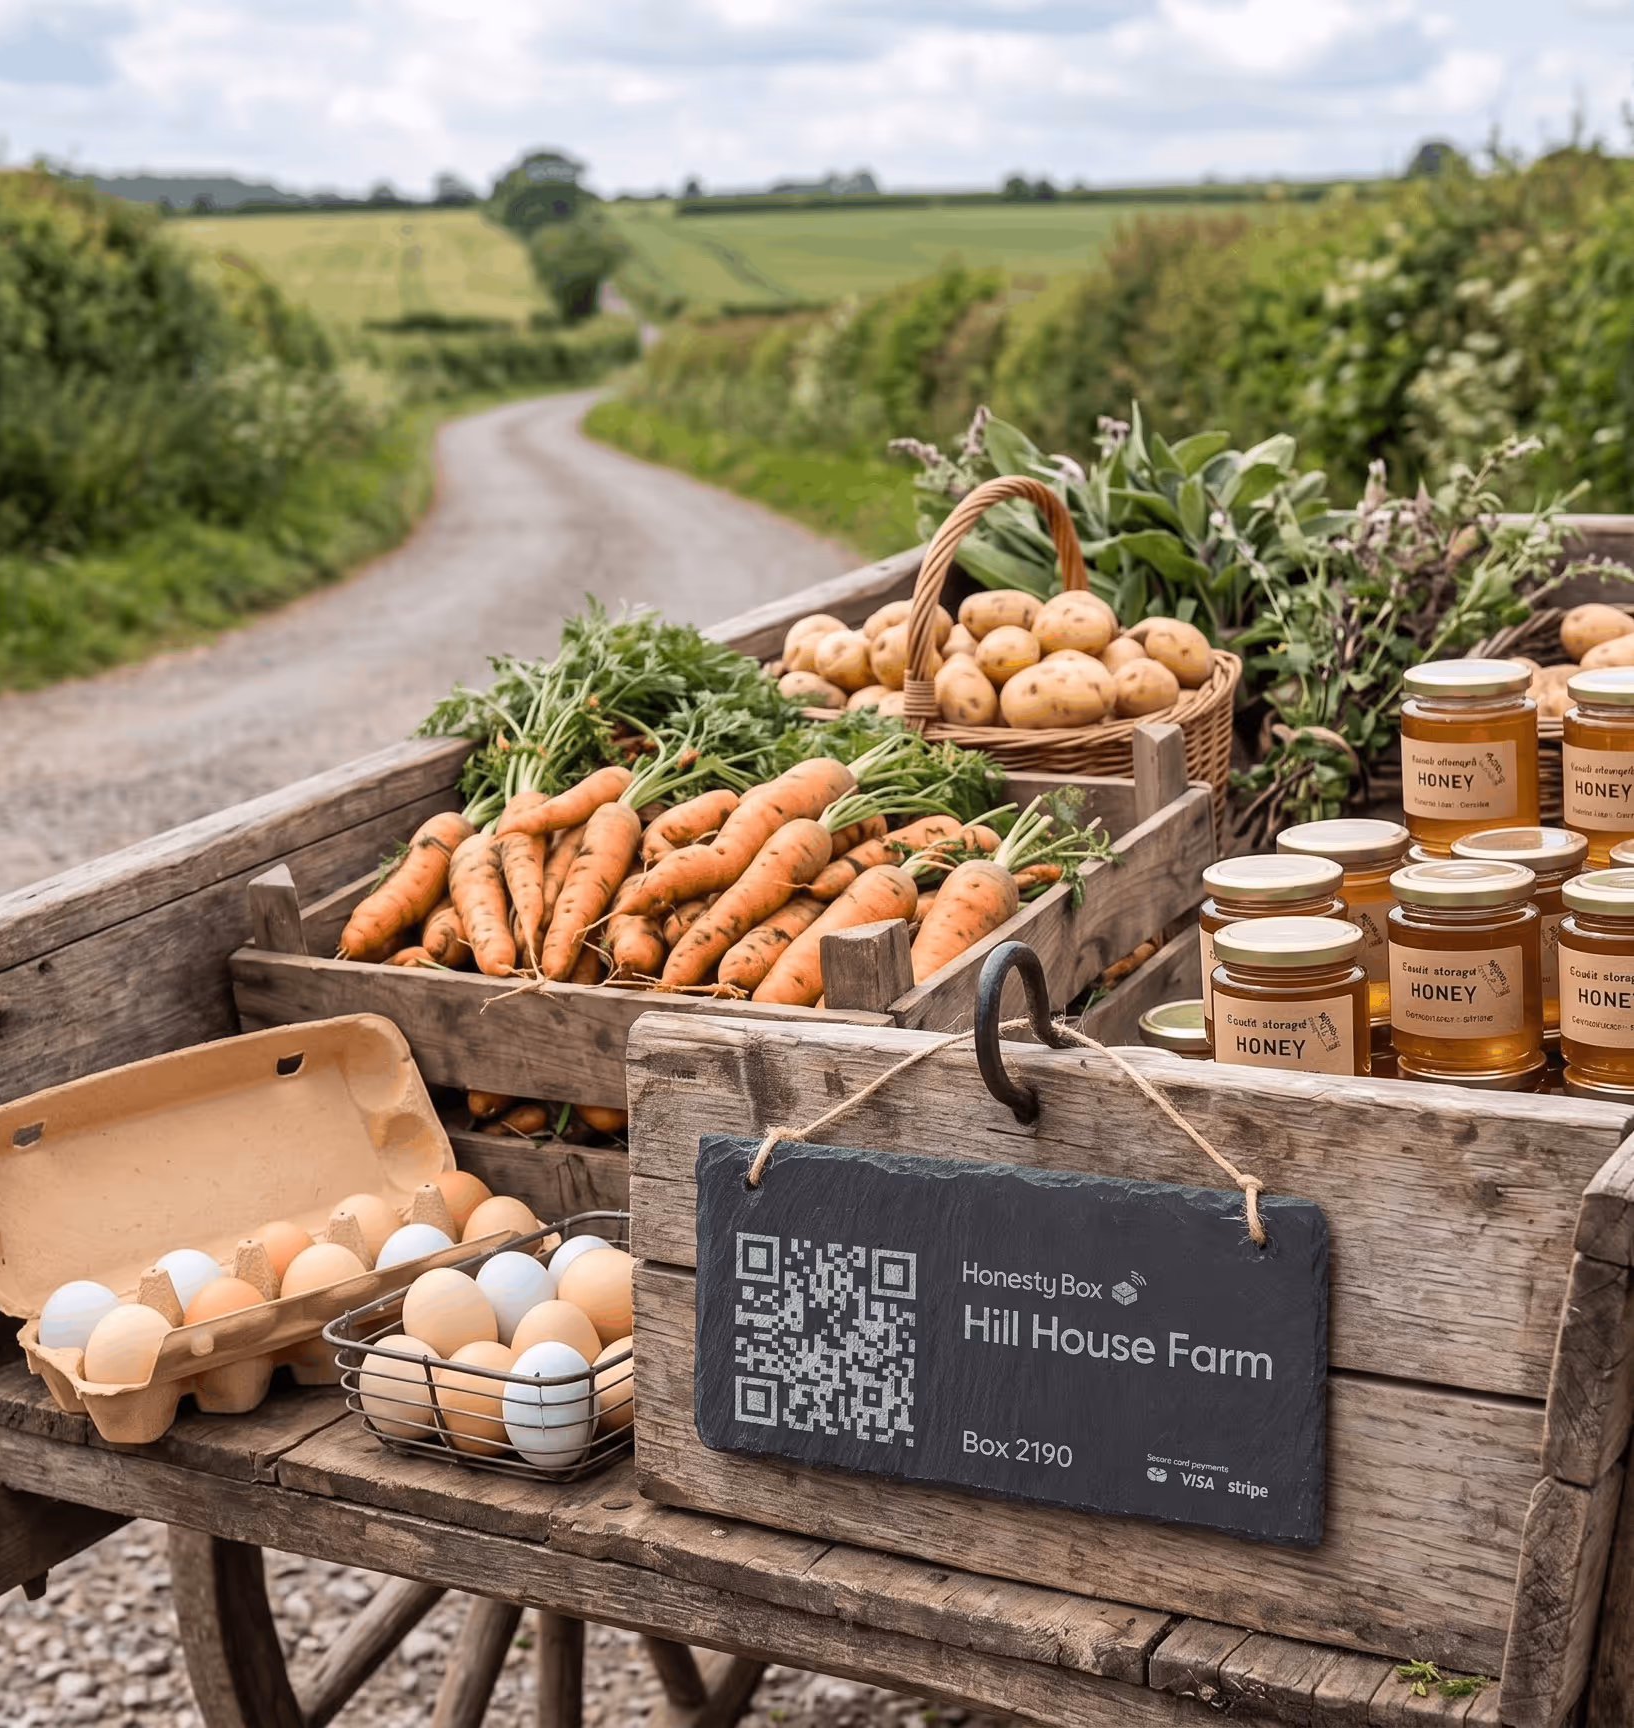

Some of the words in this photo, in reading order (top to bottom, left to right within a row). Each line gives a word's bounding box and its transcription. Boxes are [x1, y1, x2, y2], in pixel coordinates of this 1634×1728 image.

[1418, 771, 1475, 792] HONEY
[1575, 780, 1633, 802] HONEY
[1411, 982, 1477, 1004] HONEY
[1578, 987, 1634, 1009] HONE
[1236, 1035, 1306, 1059] HONEY
[962, 1260, 1057, 1299] Honesty
[1061, 1272, 1103, 1300] Box
[964, 1304, 1019, 1347] Hill
[1032, 1313, 1156, 1365] House
[1168, 1331, 1273, 1381] Farm
[963, 1430, 1010, 1459] Box
[1015, 1438, 1073, 1468] 2190
[1179, 1471, 1215, 1491] VISA
[1227, 1480, 1269, 1499] stripe
